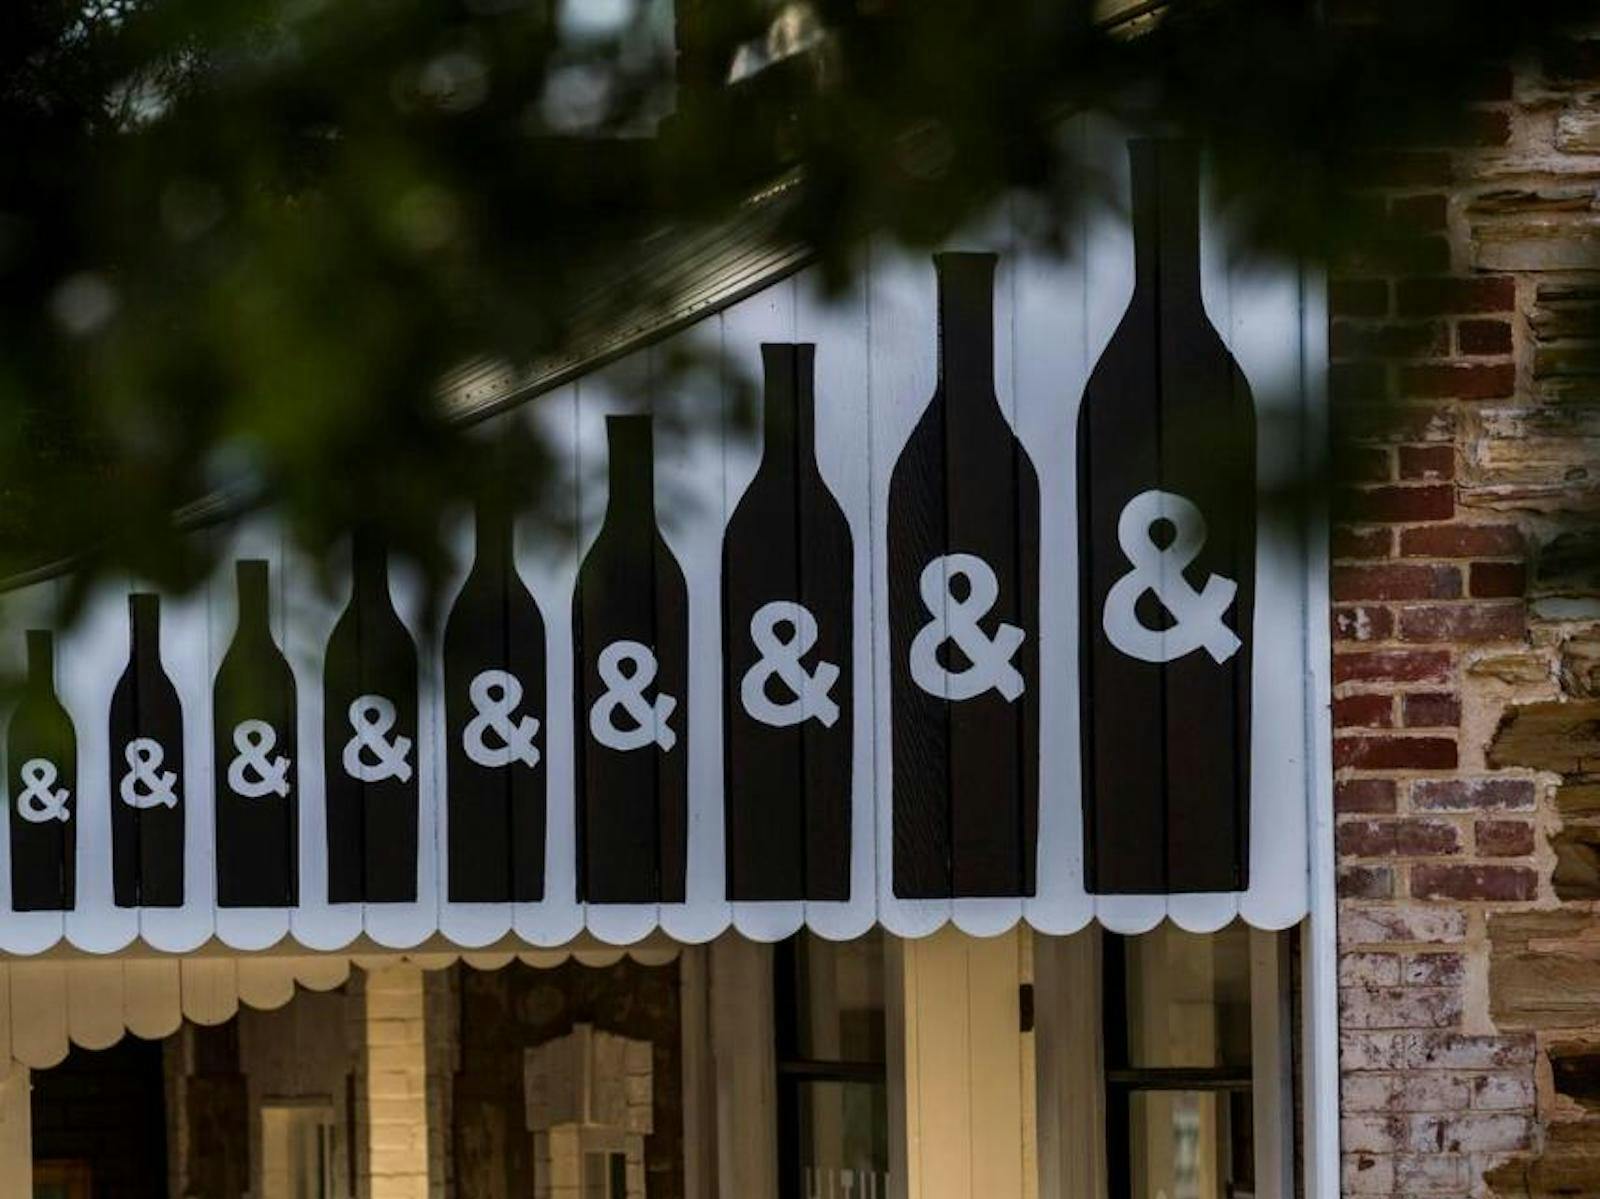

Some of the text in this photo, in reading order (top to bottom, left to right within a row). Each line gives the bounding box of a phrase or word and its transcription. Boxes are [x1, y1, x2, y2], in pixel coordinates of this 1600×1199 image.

[1103, 490, 1242, 664] &
[742, 601, 839, 727] &
[910, 554, 1025, 702] &
[343, 696, 411, 782] &
[463, 670, 539, 767] &
[590, 641, 676, 751] &
[18, 759, 70, 822] &
[121, 738, 177, 808] &
[228, 720, 290, 797] &
